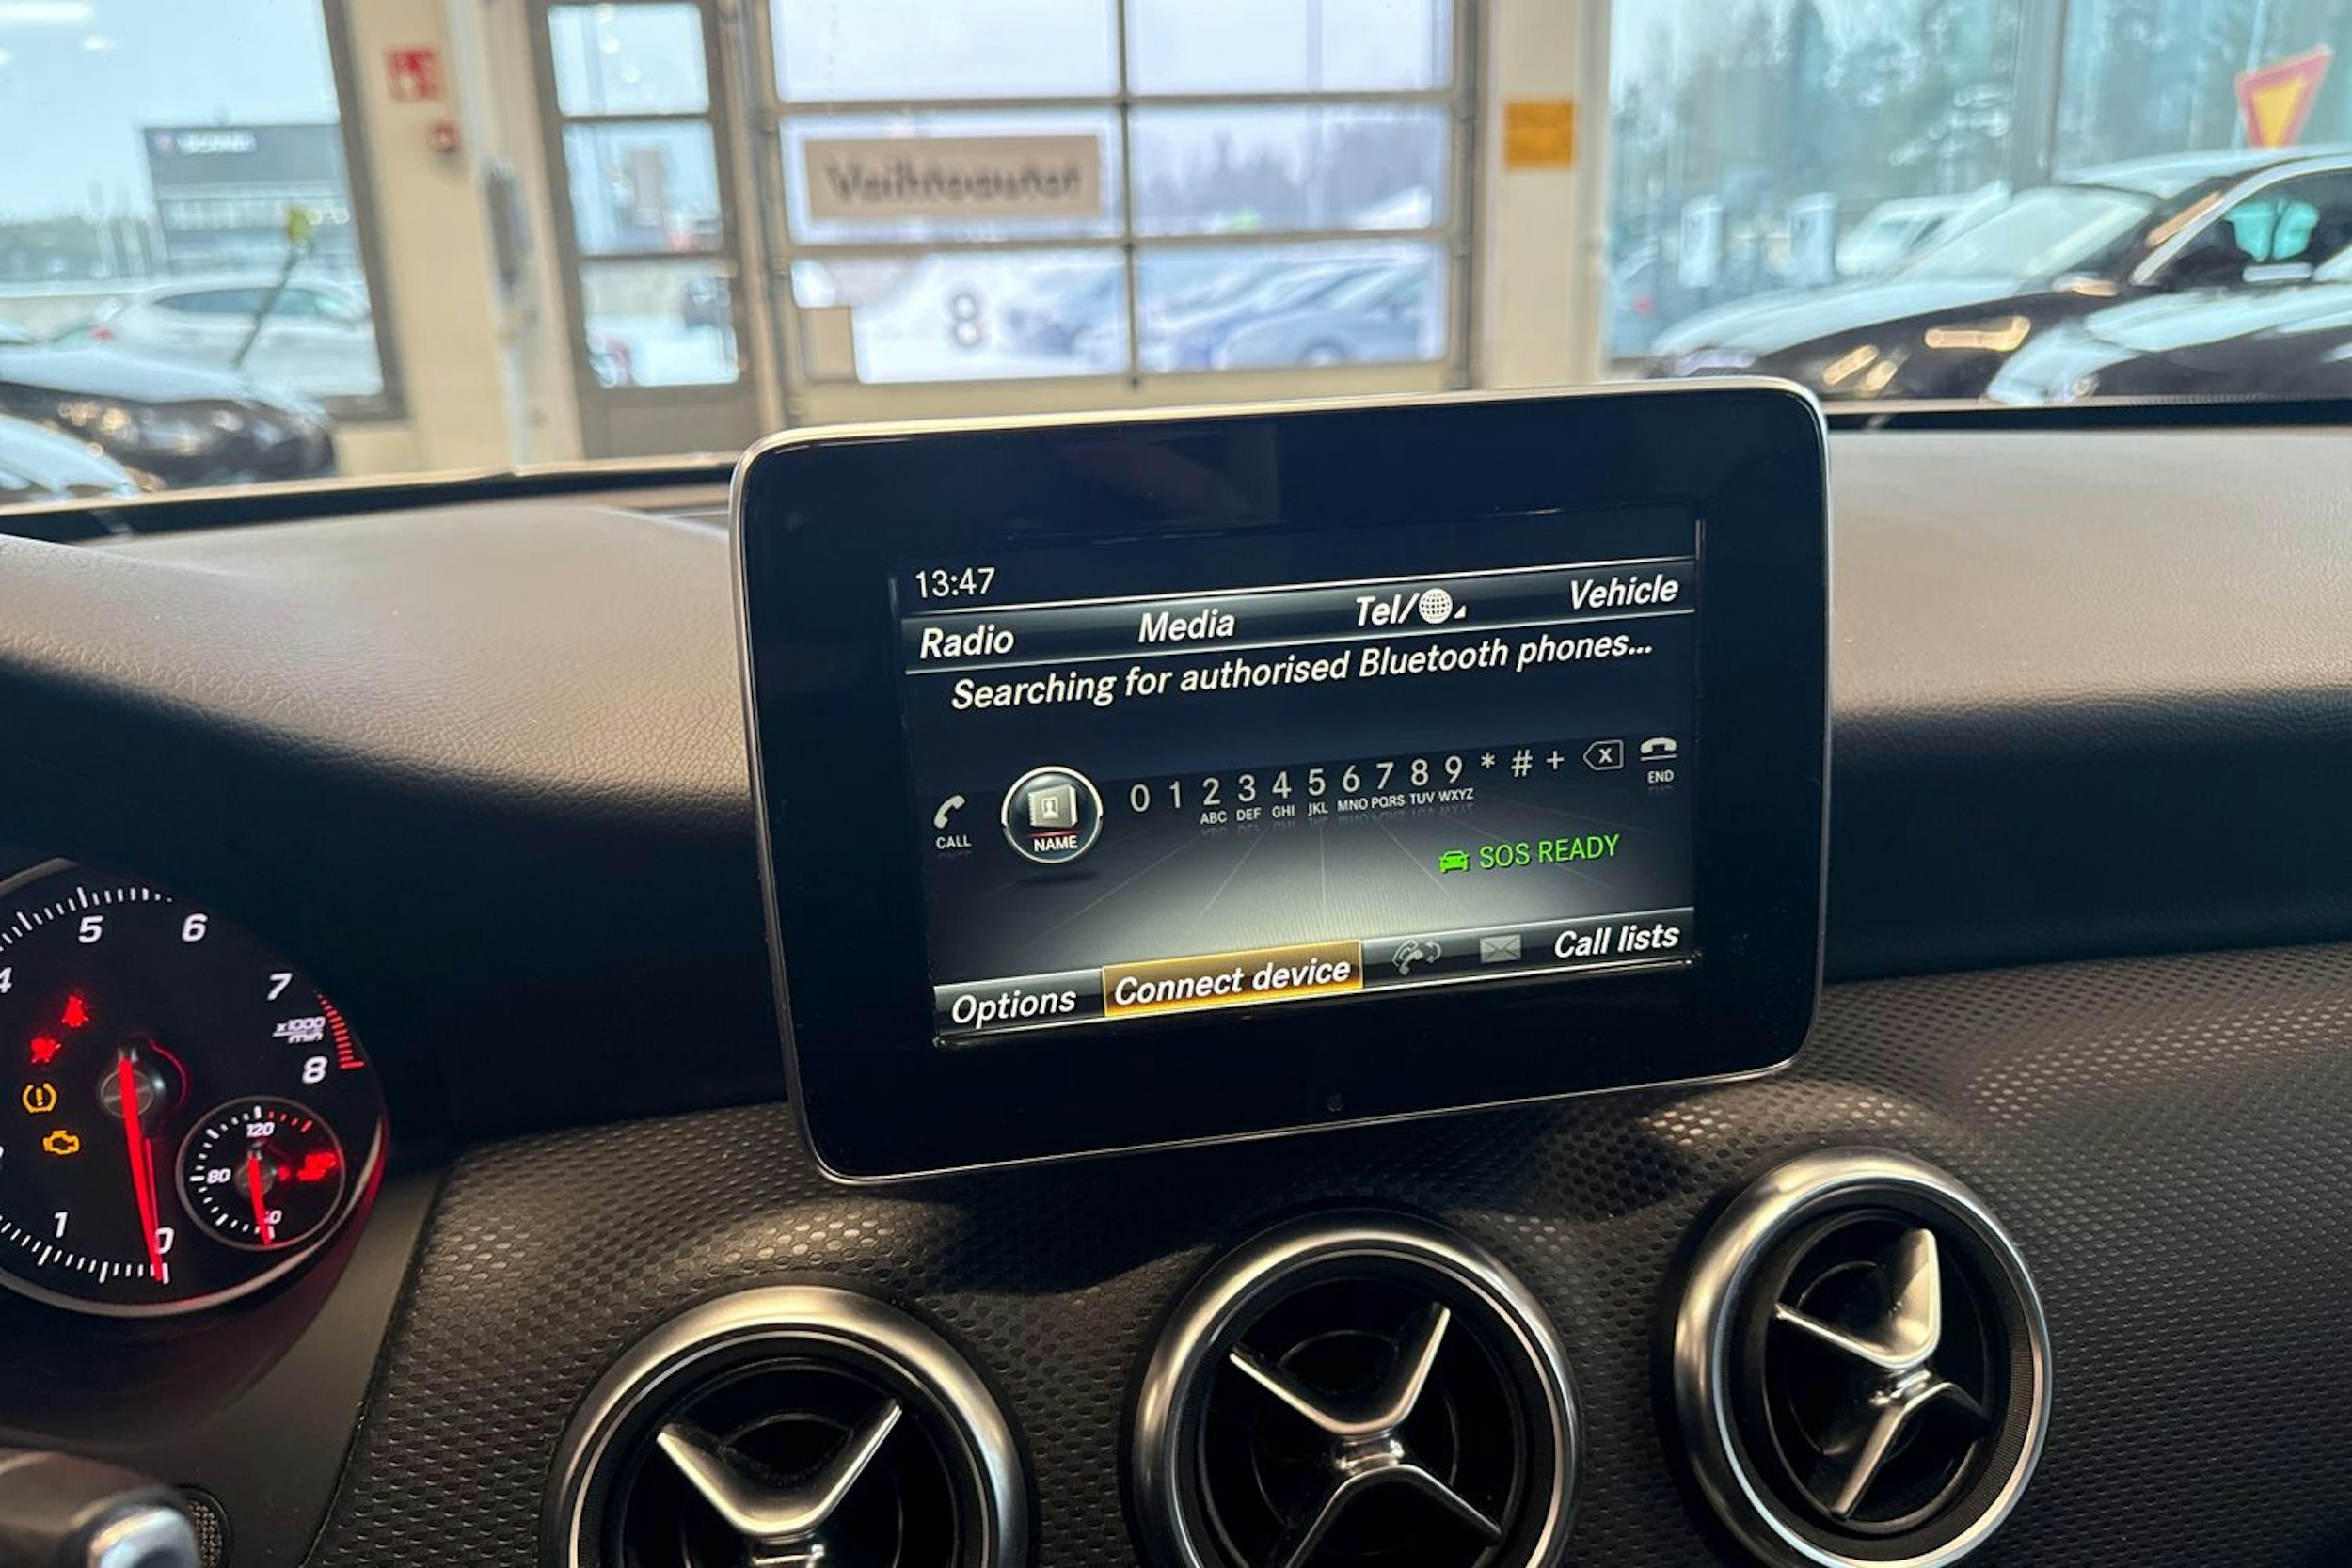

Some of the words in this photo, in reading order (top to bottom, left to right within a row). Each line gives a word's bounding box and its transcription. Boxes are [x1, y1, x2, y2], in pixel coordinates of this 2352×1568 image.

[948, 290, 981, 351] 8
[916, 567, 994, 598] 13:47
[1572, 575, 1677, 608] Vehicle
[921, 625, 1013, 657] Radio
[1138, 608, 1234, 643] Media
[951, 671, 1117, 708] Searching
[1126, 667, 1172, 695] for
[1180, 649, 1350, 689] authorised
[1359, 639, 1507, 676] Bluetooth
[1517, 635, 1651, 672] phones...
[1131, 784, 1149, 811] 0
[1170, 782, 1180, 808] 1
[1203, 778, 1220, 805] 2
[1239, 775, 1255, 801] 3
[1273, 772, 1291, 798] 4
[1309, 769, 1325, 795] 5
[1343, 766, 1359, 792] 6
[1377, 763, 1393, 789] 7
[1411, 759, 1428, 785] 8
[1445, 756, 1462, 783] 9
[1511, 750, 1533, 777] #
[1648, 770, 1673, 783] END
[1201, 812, 1226, 823] ABC
[1237, 808, 1260, 820] DEF
[1273, 806, 1294, 817] GHI
[1309, 803, 1327, 816] JKL
[1338, 799, 1368, 811] MNO
[1372, 795, 1405, 808] PQRS
[1410, 793, 1434, 804] TUV
[1439, 788, 1472, 801] WXYZ
[937, 836, 970, 848] CALL
[1034, 836, 1077, 852] NAME
[1480, 845, 1530, 868] SOS
[1540, 835, 1617, 862] READY
[79, 916, 103, 942] 5
[183, 914, 207, 942] 6
[1556, 928, 1610, 957] Call
[1619, 926, 1678, 950] lists
[268, 974, 292, 999] 7
[1114, 967, 1243, 1006] Connect
[1252, 958, 1351, 990] device
[951, 990, 1076, 1028] Options
[303, 1056, 326, 1083] 8
[247, 1122, 275, 1137] 120
[207, 1169, 230, 1183] 80
[55, 1212, 67, 1237] 1
